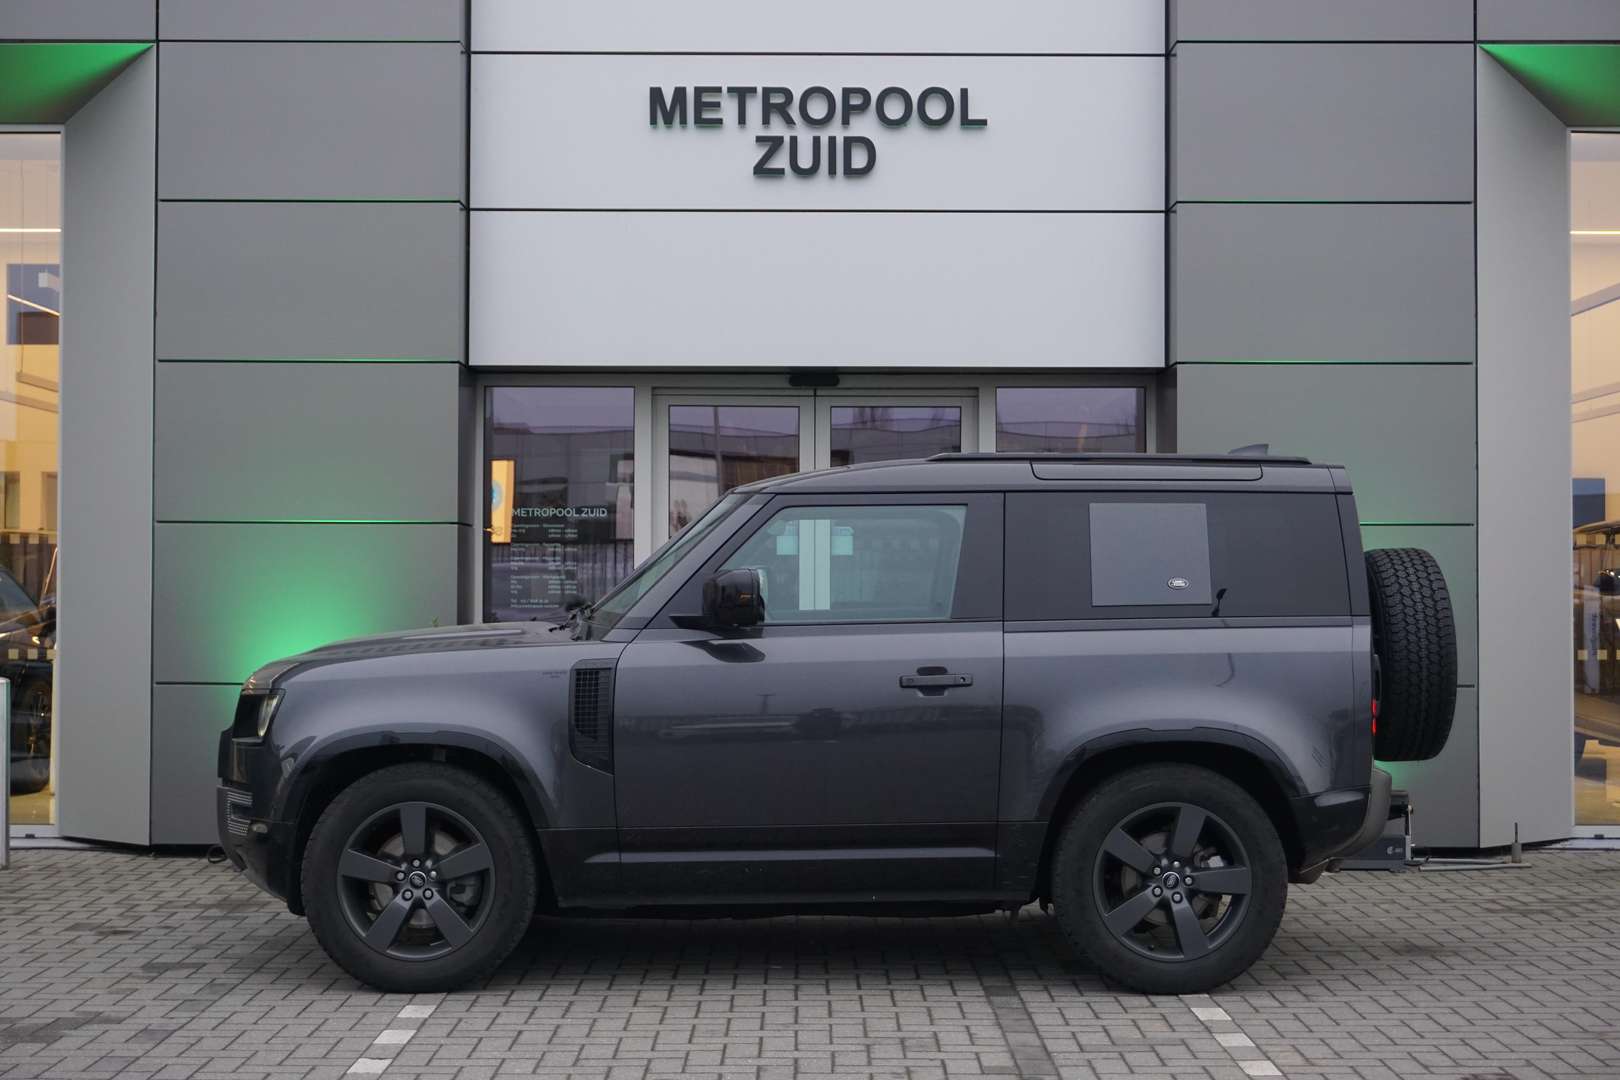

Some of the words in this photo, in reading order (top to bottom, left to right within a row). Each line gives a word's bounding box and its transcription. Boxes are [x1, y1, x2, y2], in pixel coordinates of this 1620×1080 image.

[649, 86, 988, 128] METROPOOL
[753, 136, 877, 177] ZUID
[511, 507, 579, 517] METROPOOL
[580, 507, 608, 517] ZUID
